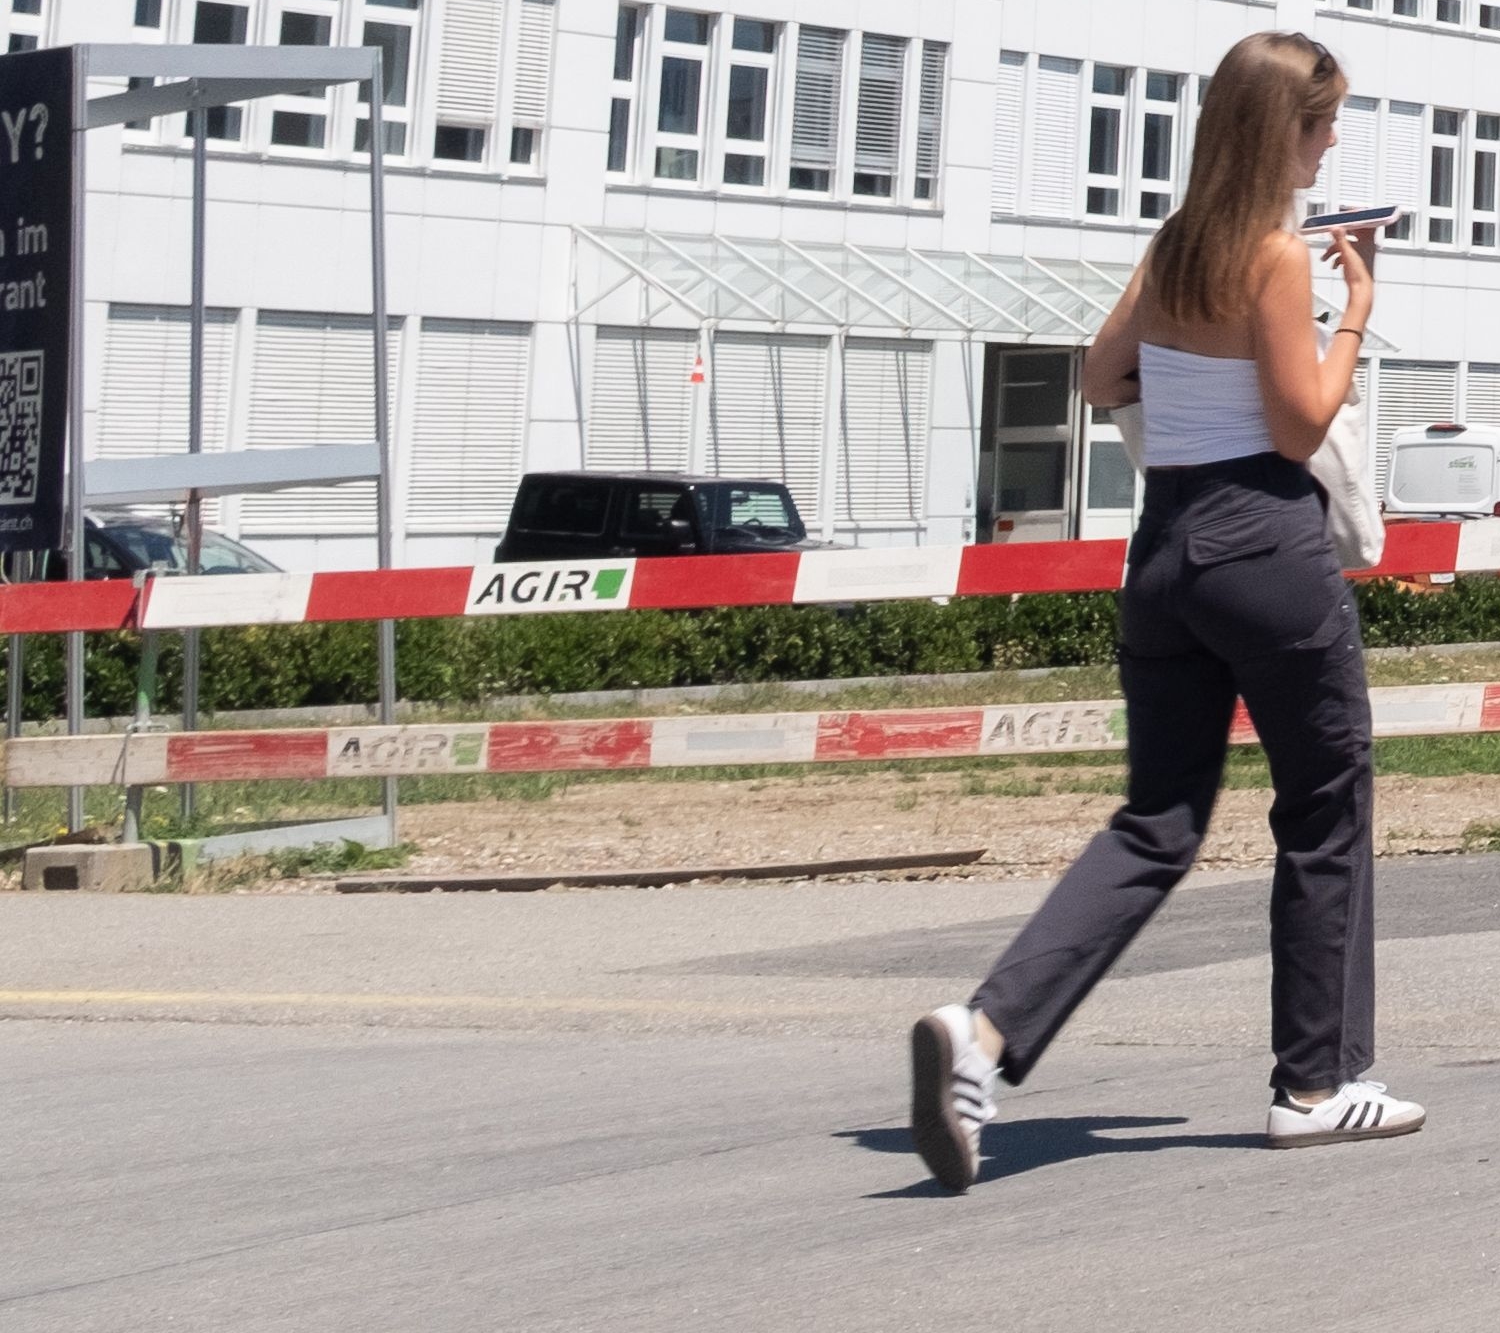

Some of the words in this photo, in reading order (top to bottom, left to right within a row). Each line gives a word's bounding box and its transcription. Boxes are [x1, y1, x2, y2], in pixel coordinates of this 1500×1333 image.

[0, 102, 49, 163] Y?
[16, 216, 48, 255] im
[0, 271, 47, 311] ant
[472, 569, 592, 606] AGIR
